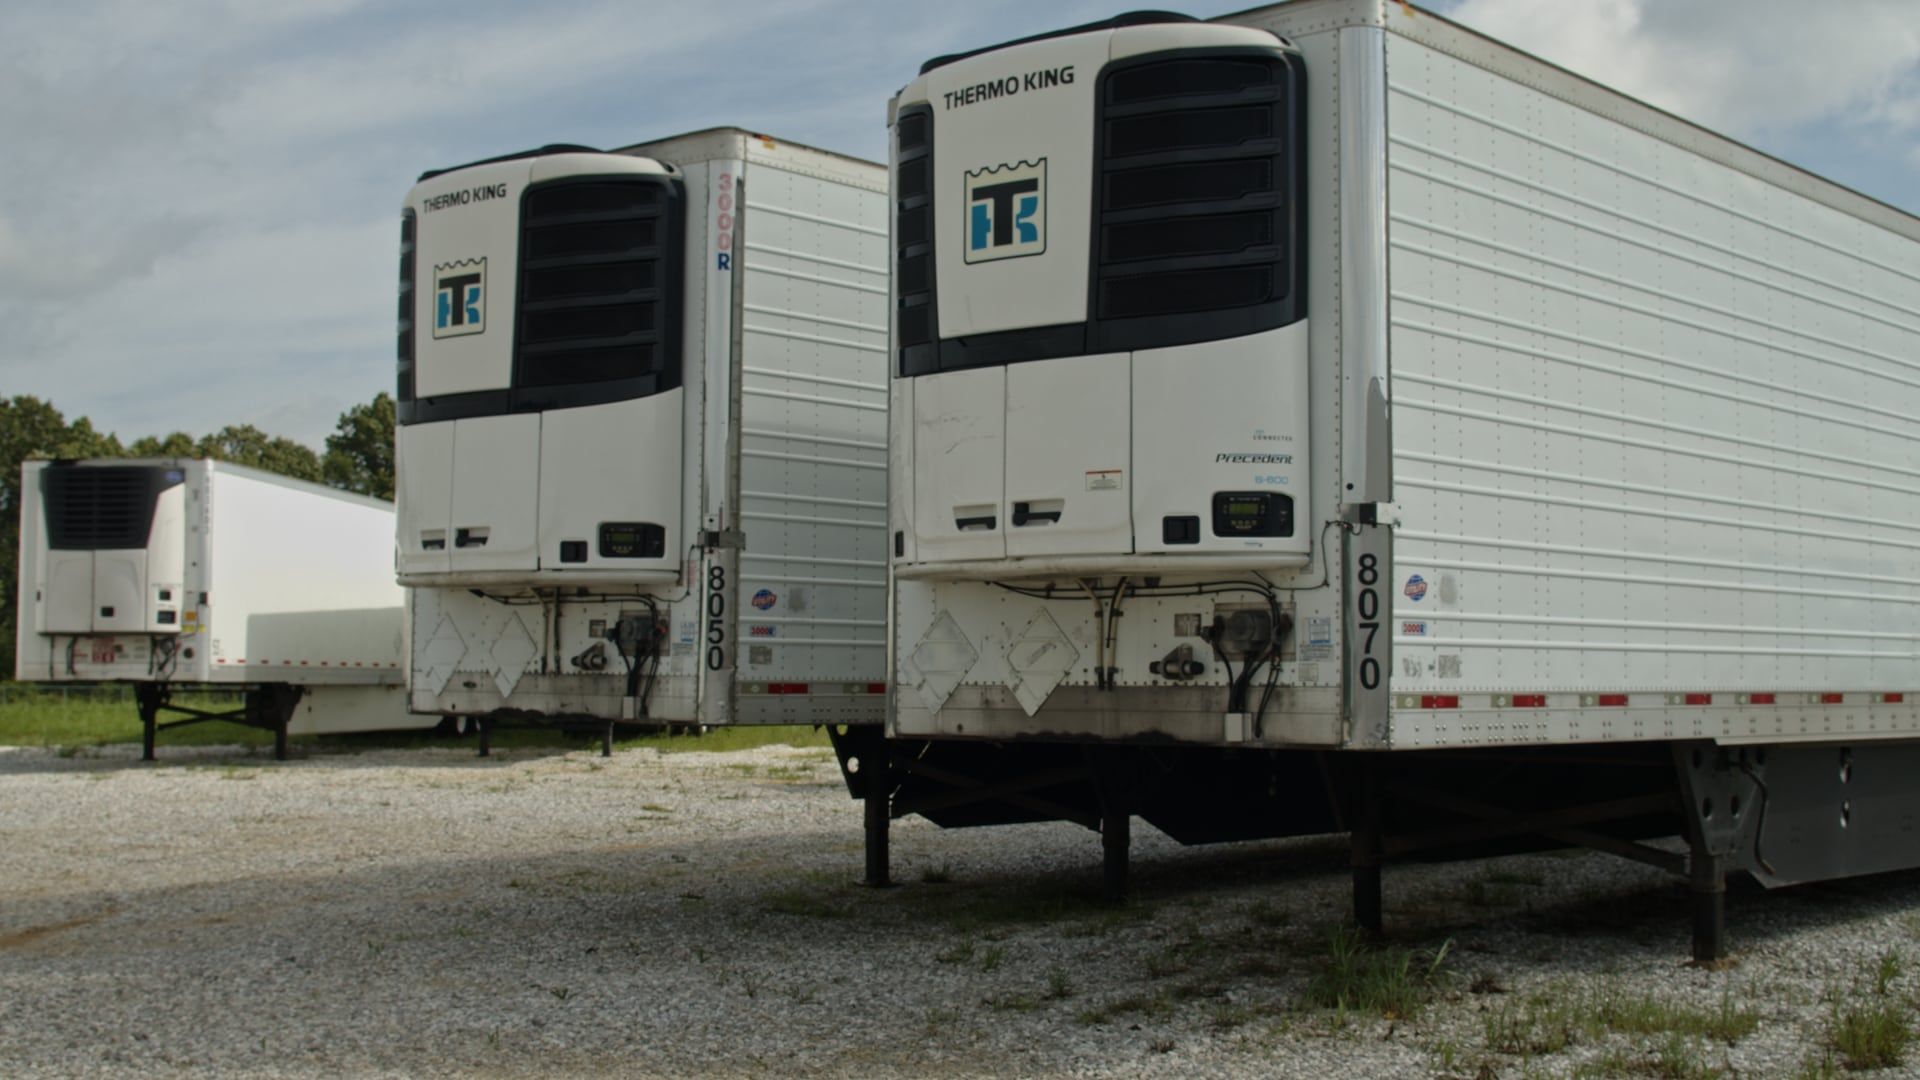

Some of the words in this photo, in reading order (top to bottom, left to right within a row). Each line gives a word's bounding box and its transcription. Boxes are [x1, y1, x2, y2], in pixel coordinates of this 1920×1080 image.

[944, 76, 1019, 110] THERMO
[1024, 65, 1075, 91] KING
[423, 188, 471, 214] THERMO
[473, 183, 507, 202] KING
[717, 173, 734, 271] 3000R
[1215, 452, 1294, 465] Precedent
[707, 566, 725, 671] 8050
[1357, 553, 1380, 690] 8070
